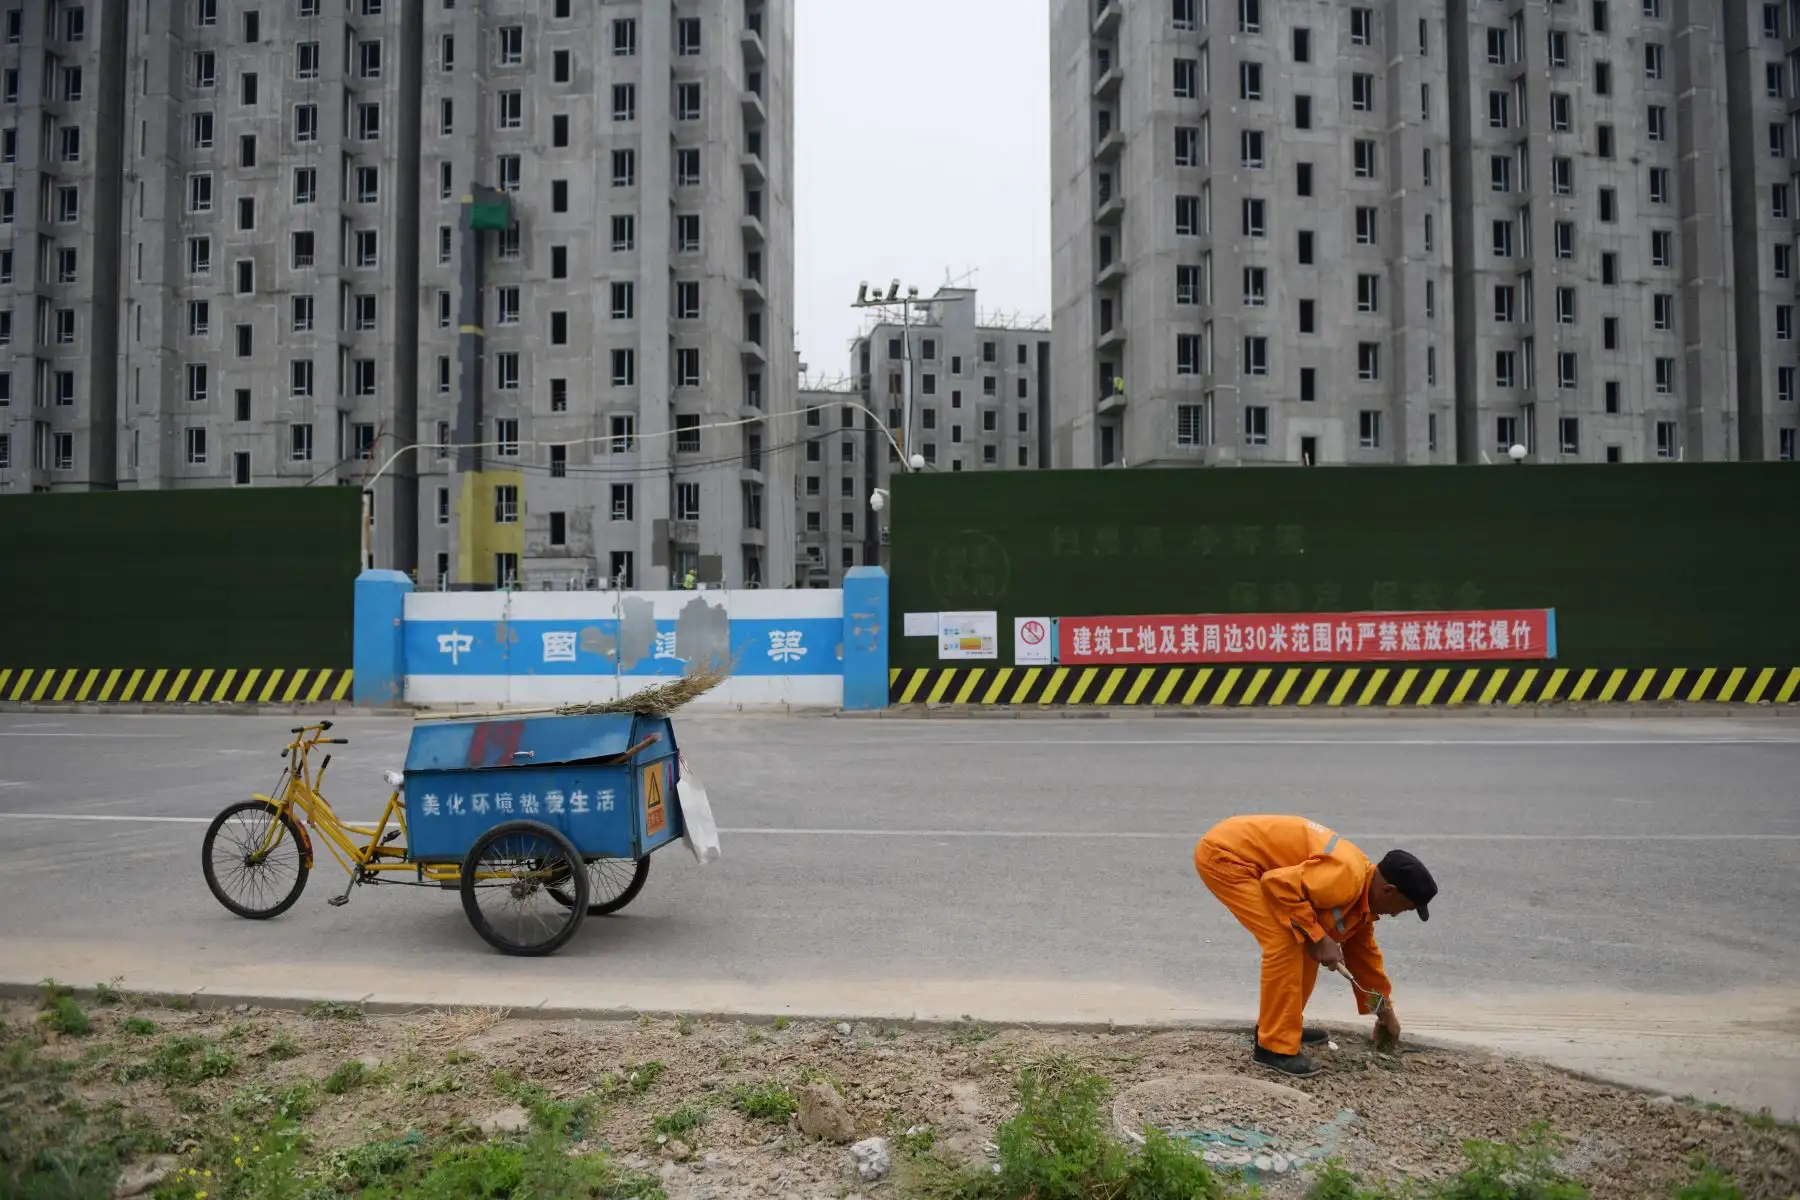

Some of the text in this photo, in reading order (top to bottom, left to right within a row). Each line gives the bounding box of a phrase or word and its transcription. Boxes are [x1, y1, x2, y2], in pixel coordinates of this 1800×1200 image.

[1073, 620, 1532, 656] 建筑工地及其周边30米范围内严禁燃放烟花爆竹
[421, 789, 616, 816] 美化环境热爱生活
